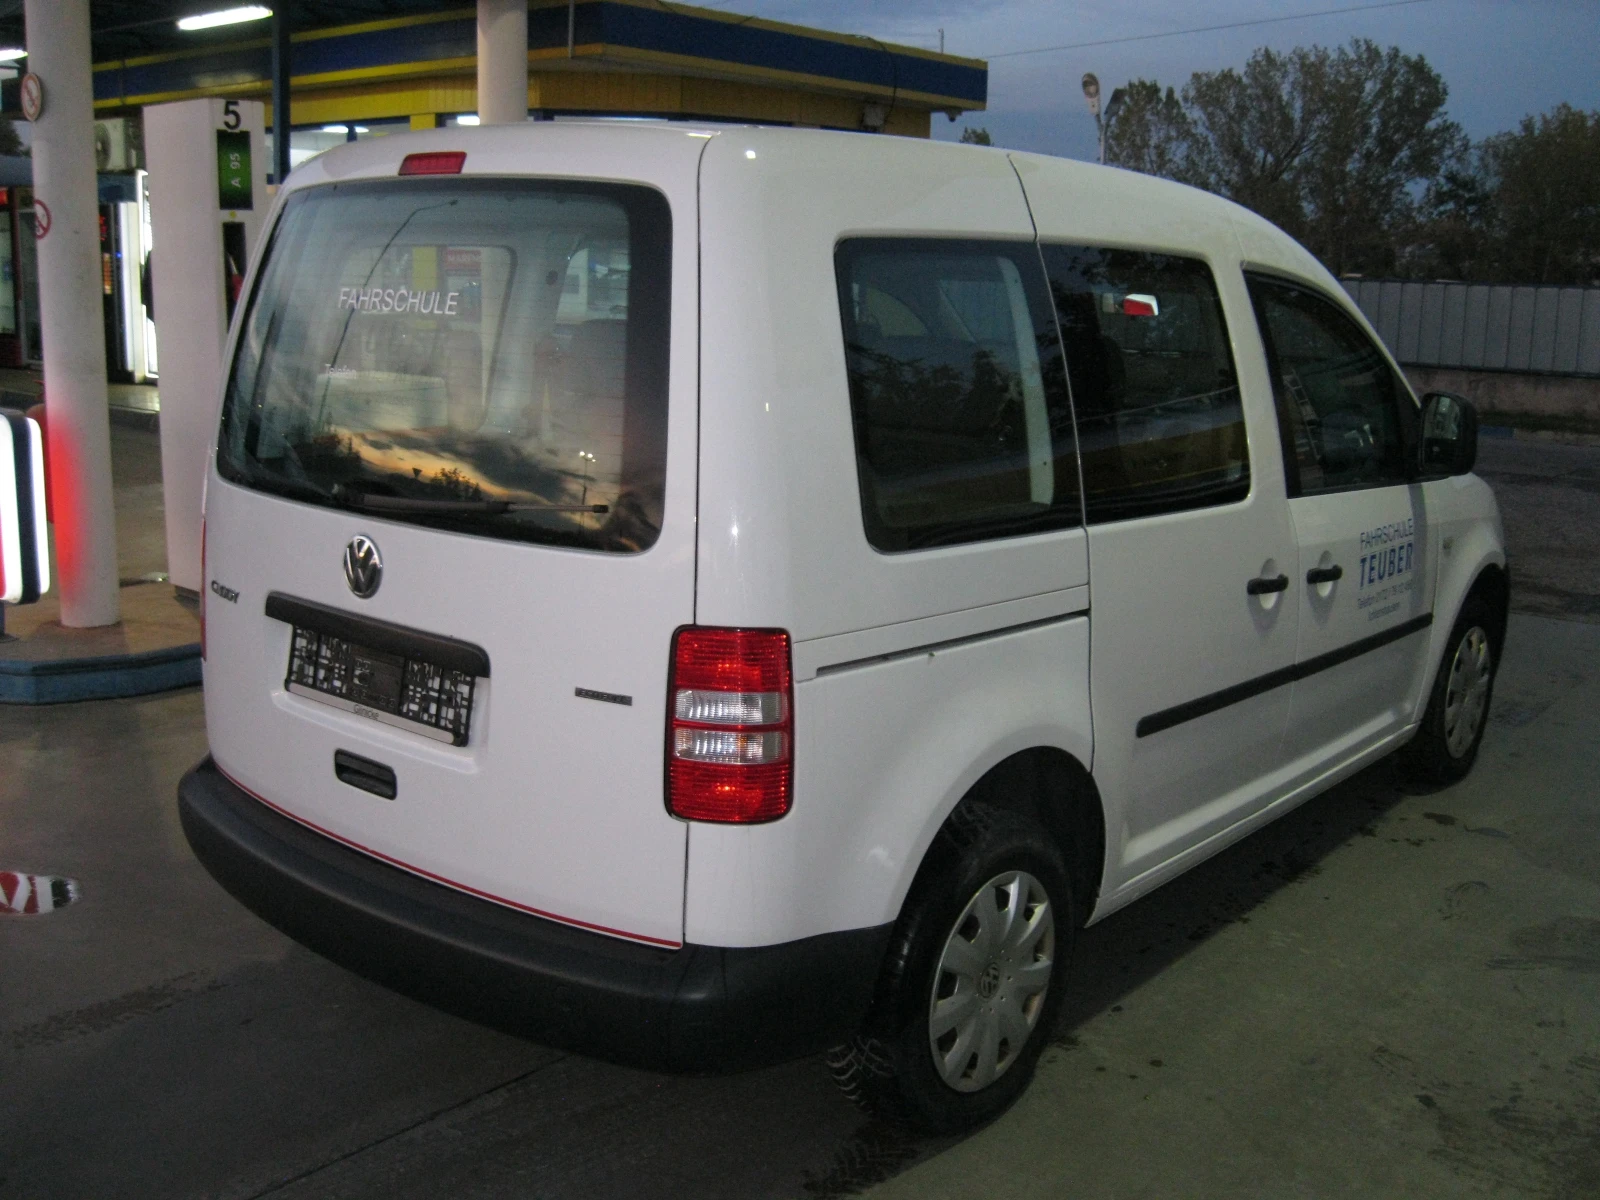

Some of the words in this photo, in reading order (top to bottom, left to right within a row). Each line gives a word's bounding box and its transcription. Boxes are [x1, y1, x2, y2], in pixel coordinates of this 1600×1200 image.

[223, 101, 242, 130] 5
[229, 153, 241, 169] 95
[231, 177, 241, 188] A
[338, 287, 460, 316] FAHRSCHULE
[1359, 518, 1414, 552] FAHRSCHULE
[1359, 541, 1414, 588] TEUBER
